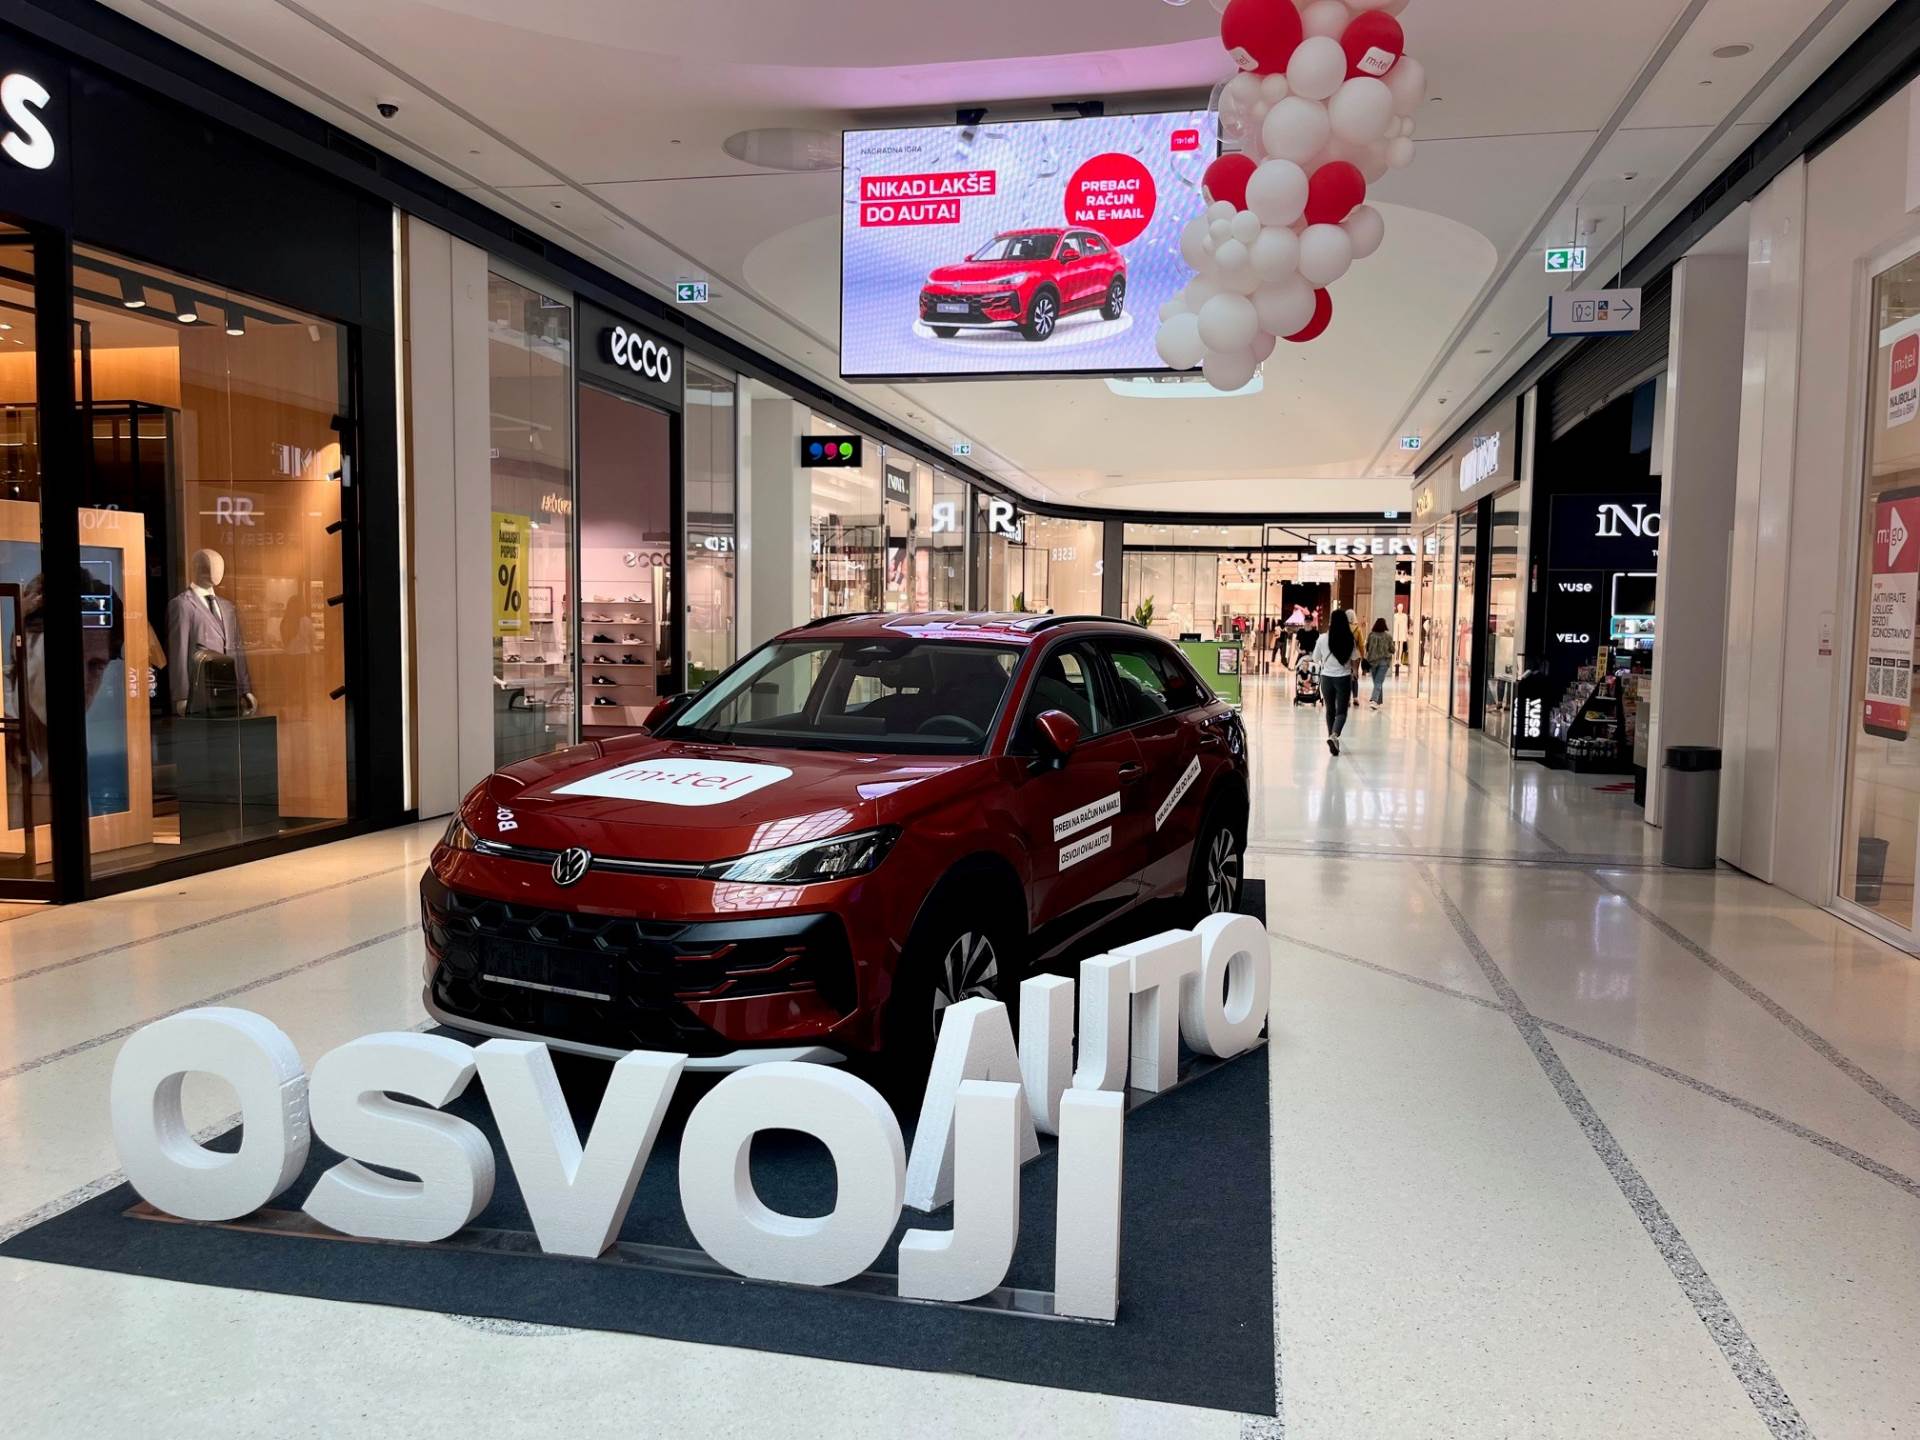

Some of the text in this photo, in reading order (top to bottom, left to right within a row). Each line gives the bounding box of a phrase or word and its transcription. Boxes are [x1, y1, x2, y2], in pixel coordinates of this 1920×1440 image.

[861, 147, 903, 155] NAGRADNA
[867, 173, 991, 198] NIKAD LAKŠE
[1081, 179, 1140, 192] PREBACI
[1086, 192, 1134, 206] RAČUN
[866, 203, 957, 222] DO AUTA!
[1075, 208, 1144, 221] NA E-MAIL
[611, 326, 672, 383] ecco
[1893, 346, 1917, 375] m:tel
[1556, 633, 1590, 643] VELO
[608, 768, 752, 791] m:tel
[1080, 809, 1099, 824] RAČUN
[1061, 847, 1081, 864] OSVOJI
[110, 1006, 1125, 1323] OSVOJI
